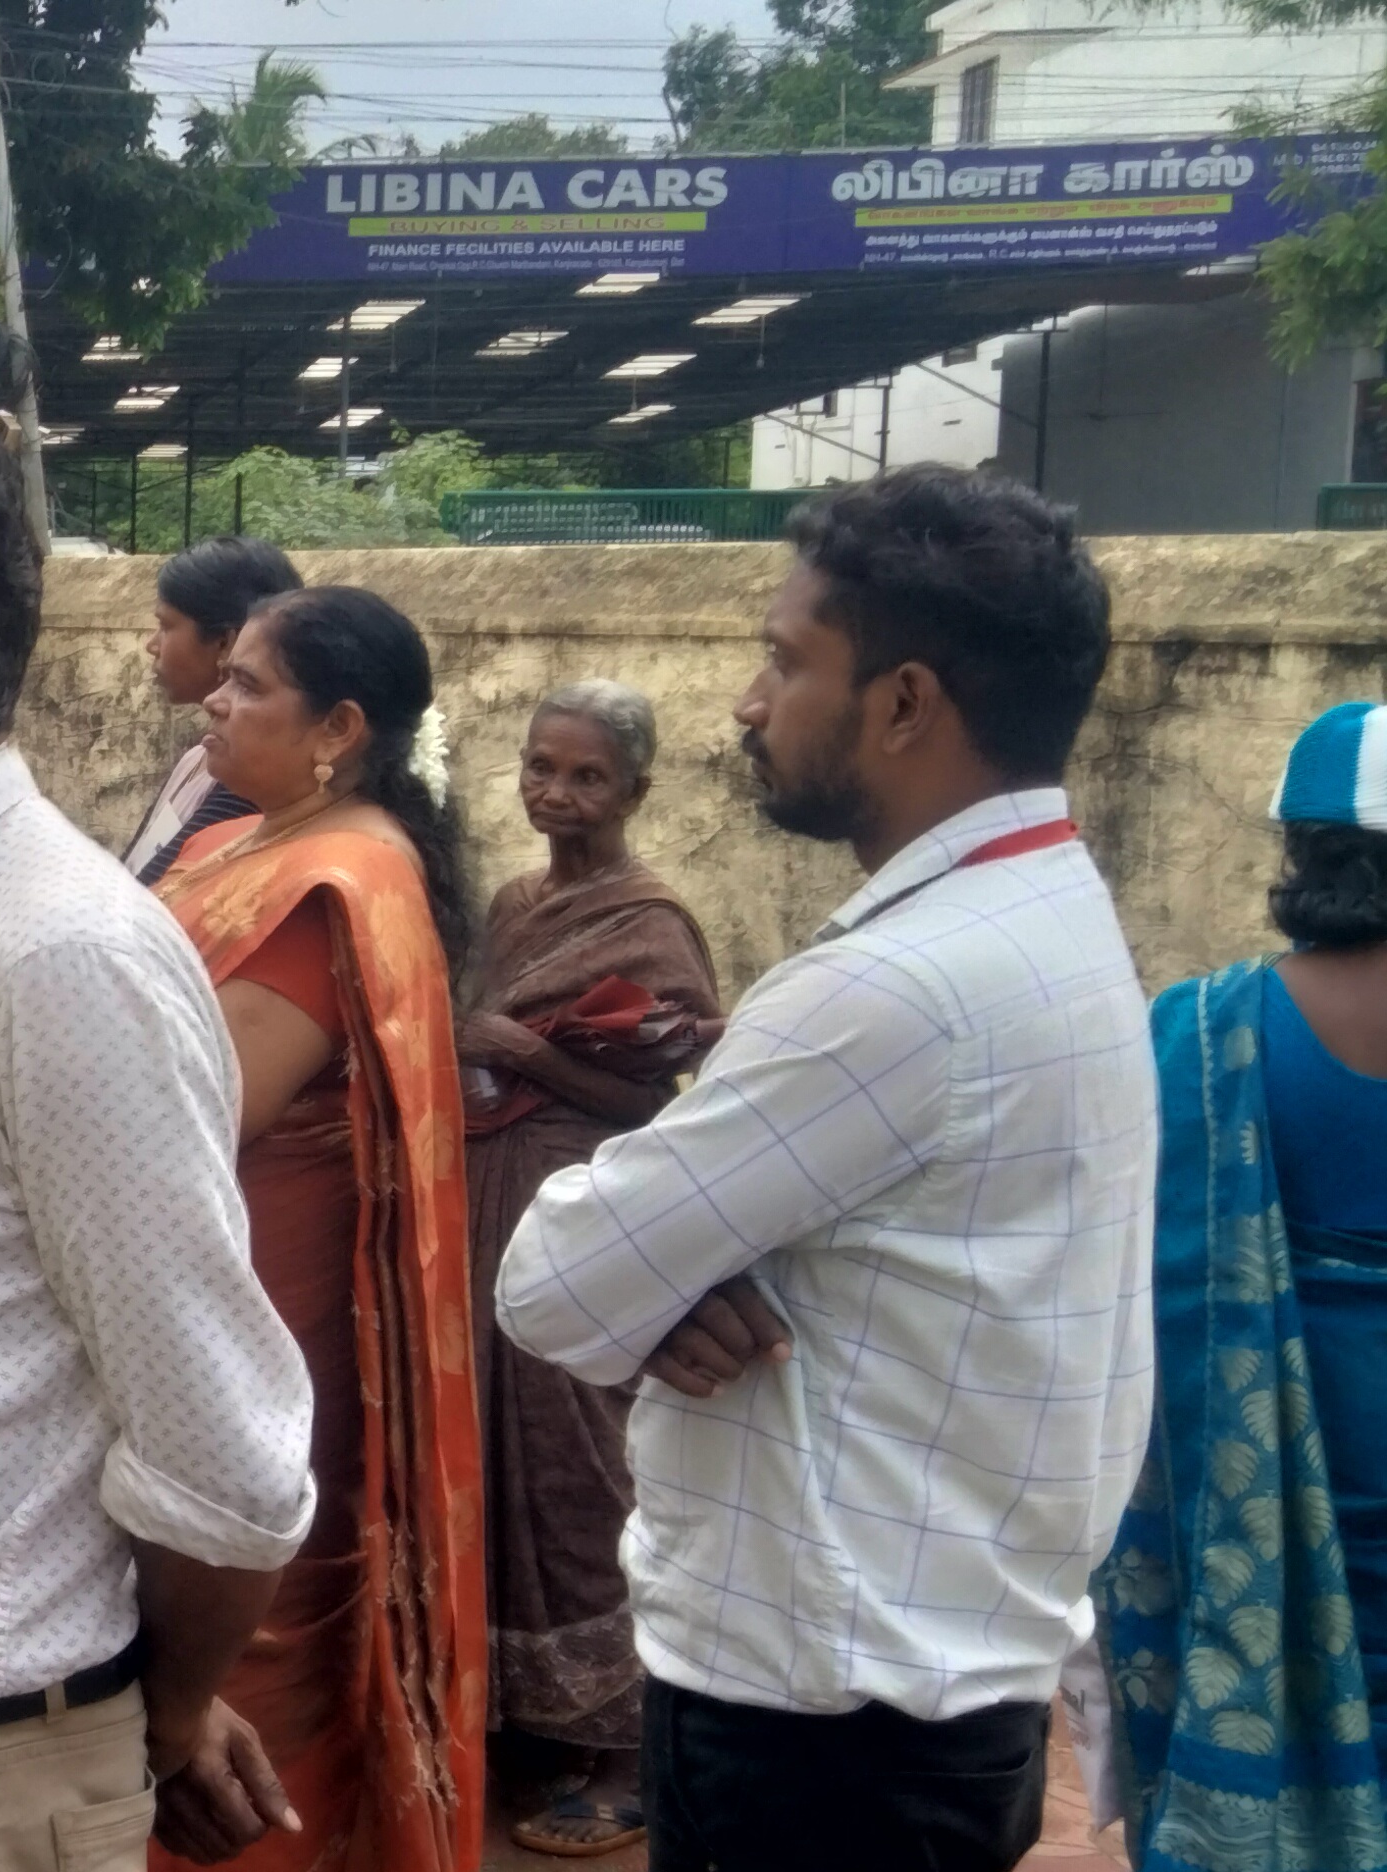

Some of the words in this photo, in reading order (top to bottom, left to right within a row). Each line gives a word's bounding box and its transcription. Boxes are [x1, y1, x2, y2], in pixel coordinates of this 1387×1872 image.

[832, 158, 1044, 201] லிபினா
[1064, 144, 1254, 193] கார்ஸ்
[327, 171, 545, 213] LIBINA
[567, 167, 728, 209] CARS
[390, 219, 500, 233] BUYING
[511, 219, 529, 231] &
[540, 216, 665, 231] SELLING
[368, 244, 441, 257] FINANCE
[446, 242, 534, 256] FECILITIES
[538, 240, 634, 254] AVAILABLE
[639, 239, 685, 252] HERE
